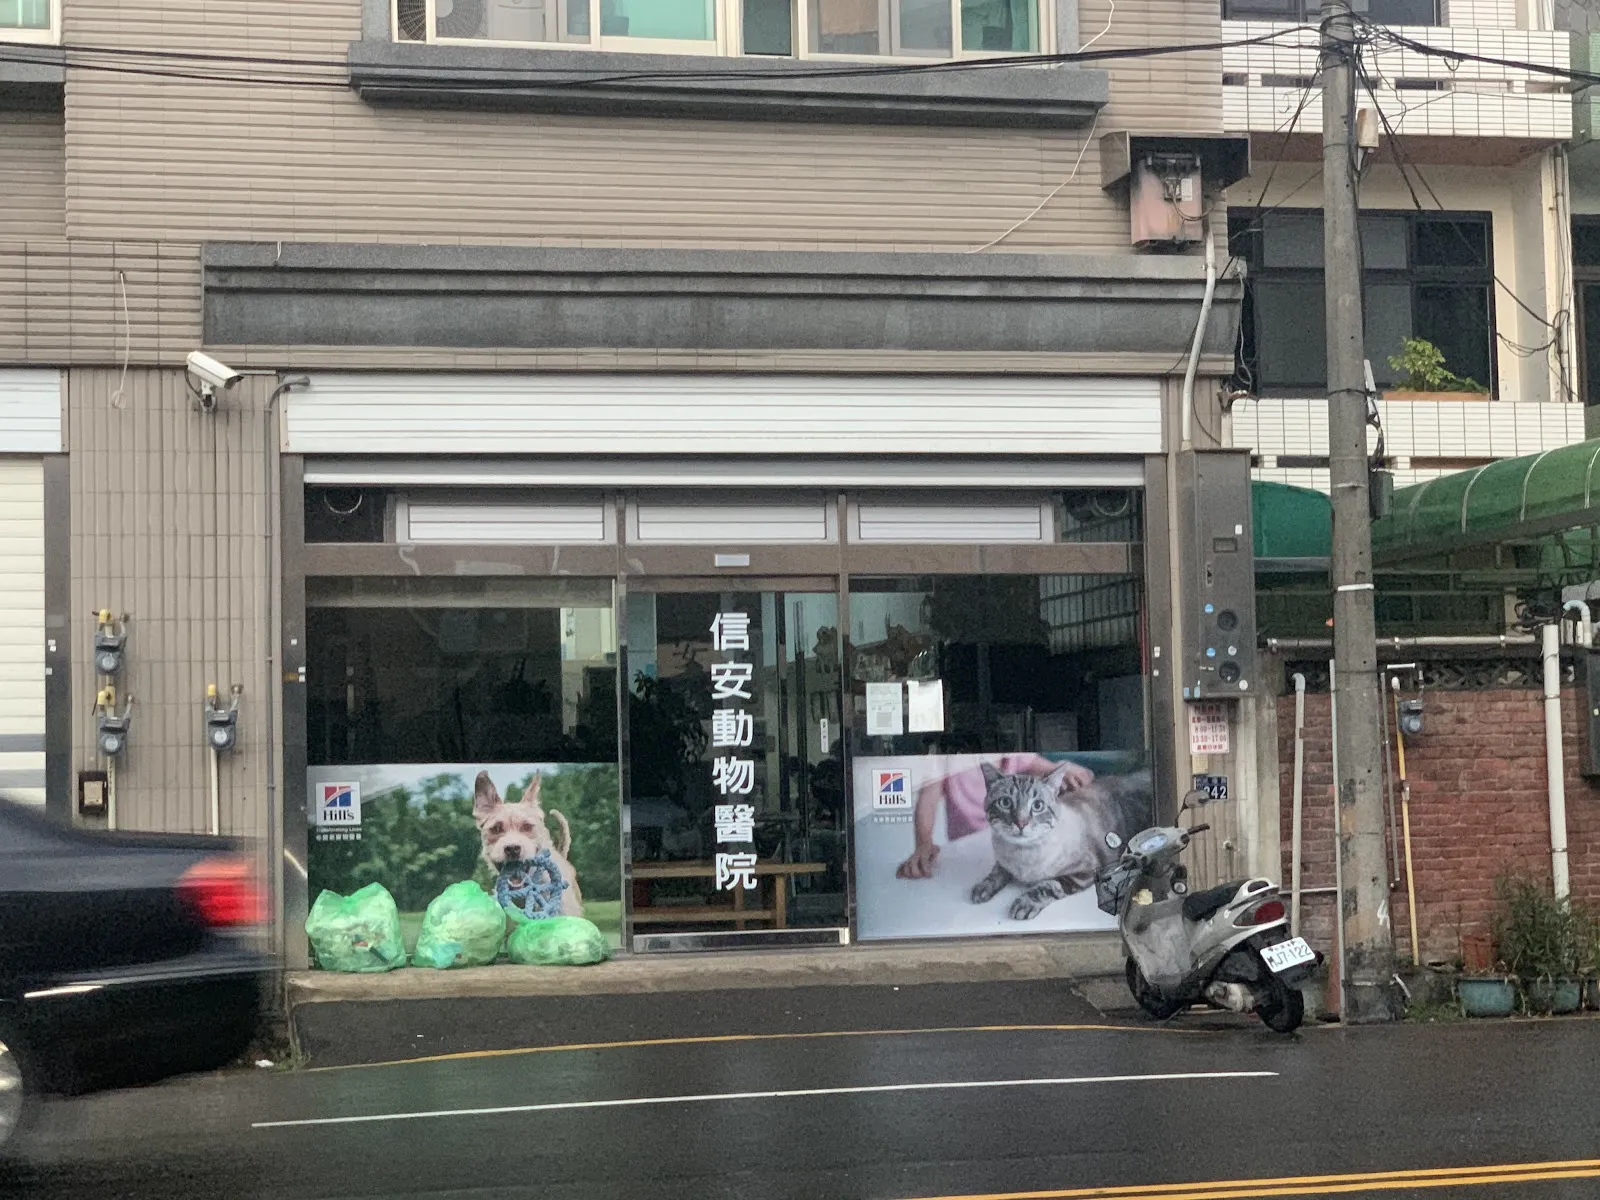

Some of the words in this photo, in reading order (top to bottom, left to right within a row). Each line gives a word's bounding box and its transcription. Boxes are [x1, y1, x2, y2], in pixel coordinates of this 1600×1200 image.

[708, 612, 758, 891] 信安動物醫院
[879, 794, 907, 805] Hill's
[323, 809, 355, 821] Hill's
[1266, 944, 1312, 969] MJ7-122
